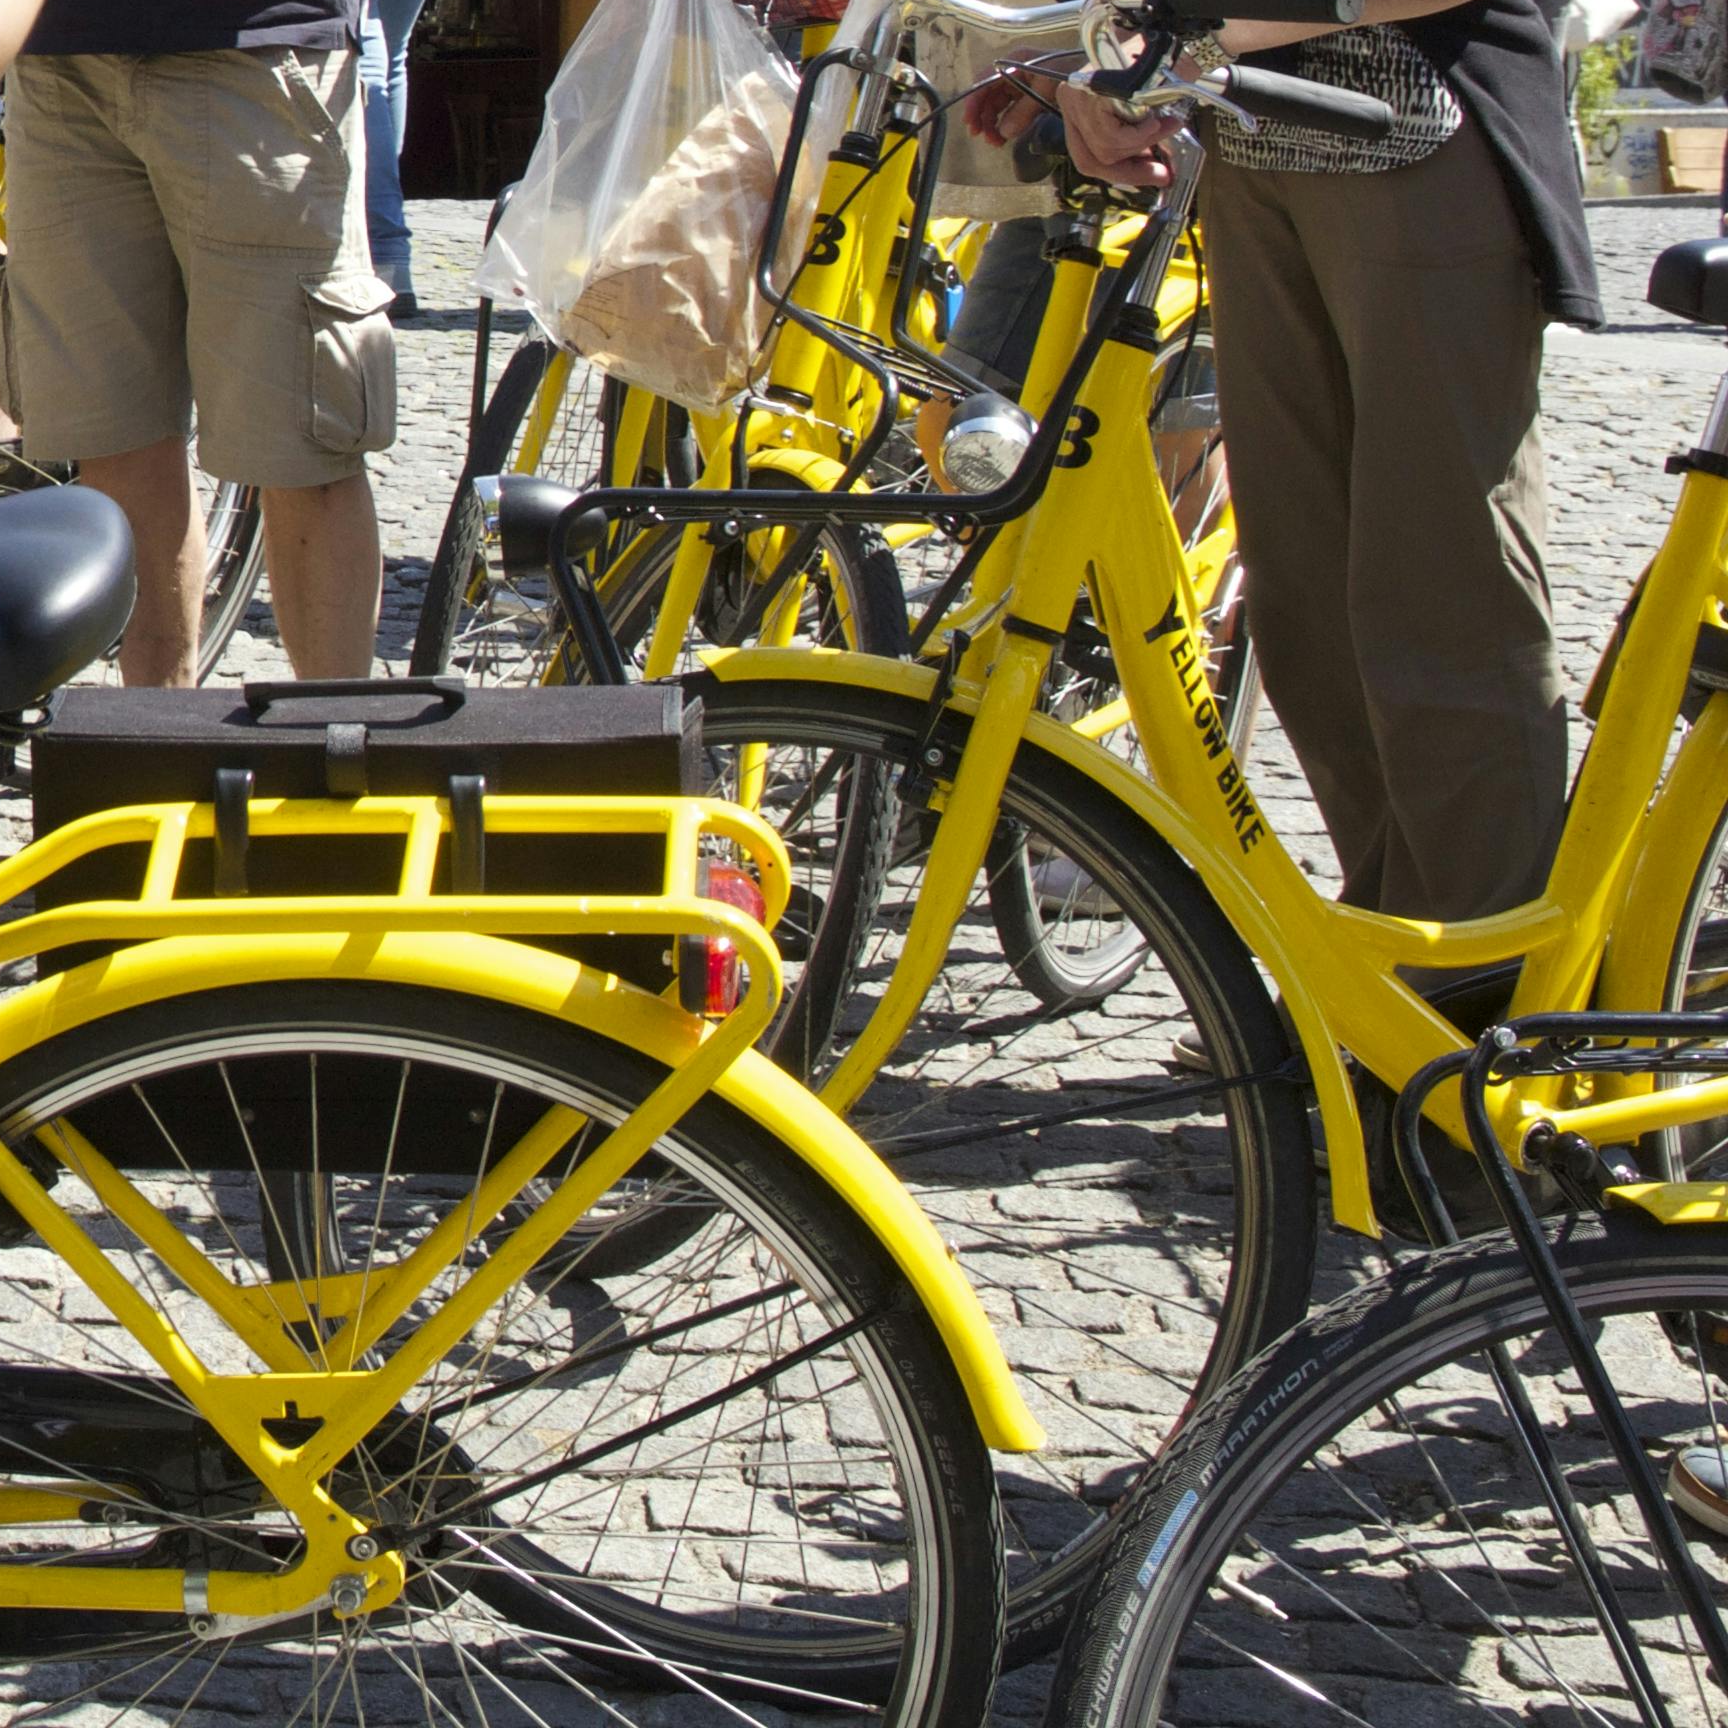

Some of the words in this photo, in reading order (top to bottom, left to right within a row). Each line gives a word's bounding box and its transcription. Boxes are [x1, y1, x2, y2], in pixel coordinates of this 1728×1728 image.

[1144, 592, 1229, 760] YELLOW
[1216, 758, 1266, 856] BIKE
[1084, 1590, 1141, 1728] CHWALBE
[1196, 1358, 1320, 1488] MARATHON
